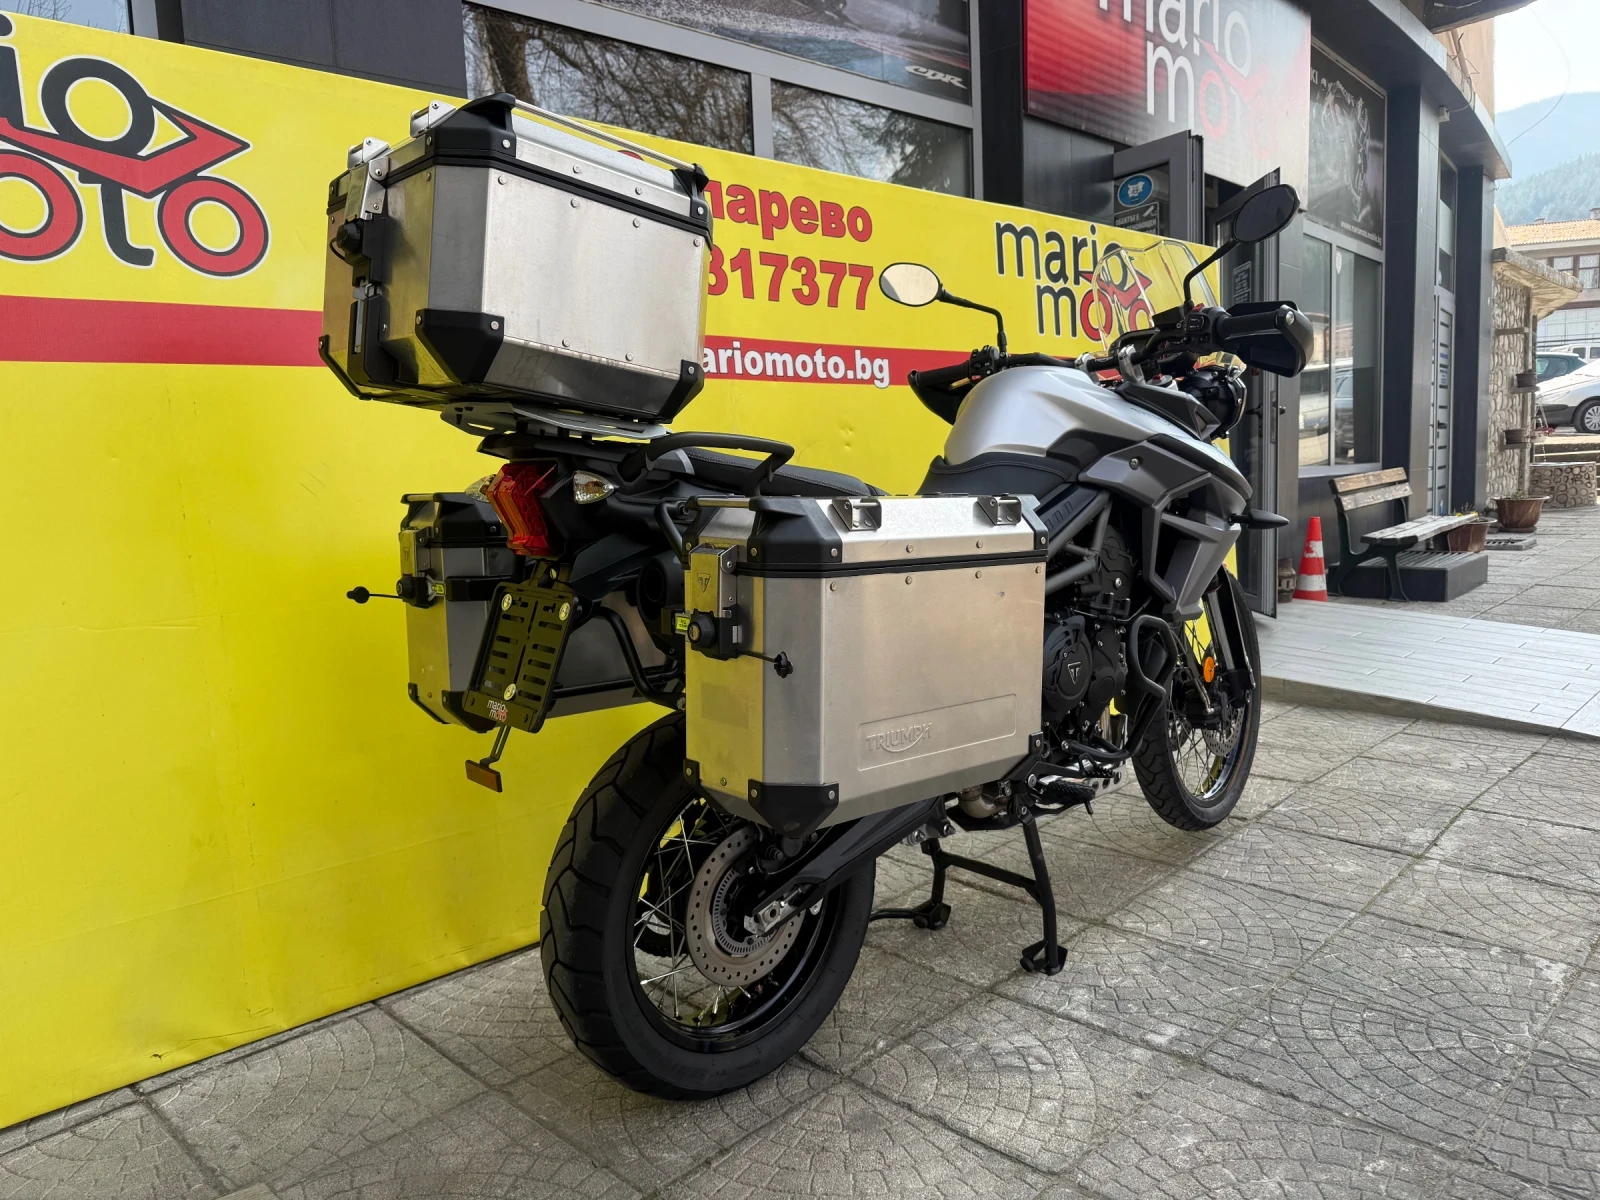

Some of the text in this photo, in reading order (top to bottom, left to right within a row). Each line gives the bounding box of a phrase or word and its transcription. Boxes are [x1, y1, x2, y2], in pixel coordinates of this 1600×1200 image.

[904, 65, 968, 90] CBR
[0, 149, 270, 278] oto
[703, 179, 873, 243] парево
[995, 220, 1129, 291] mario
[702, 339, 891, 390] ariomoto.bg
[486, 699, 506, 713] mario
[865, 722, 932, 752] TRIUMPH
